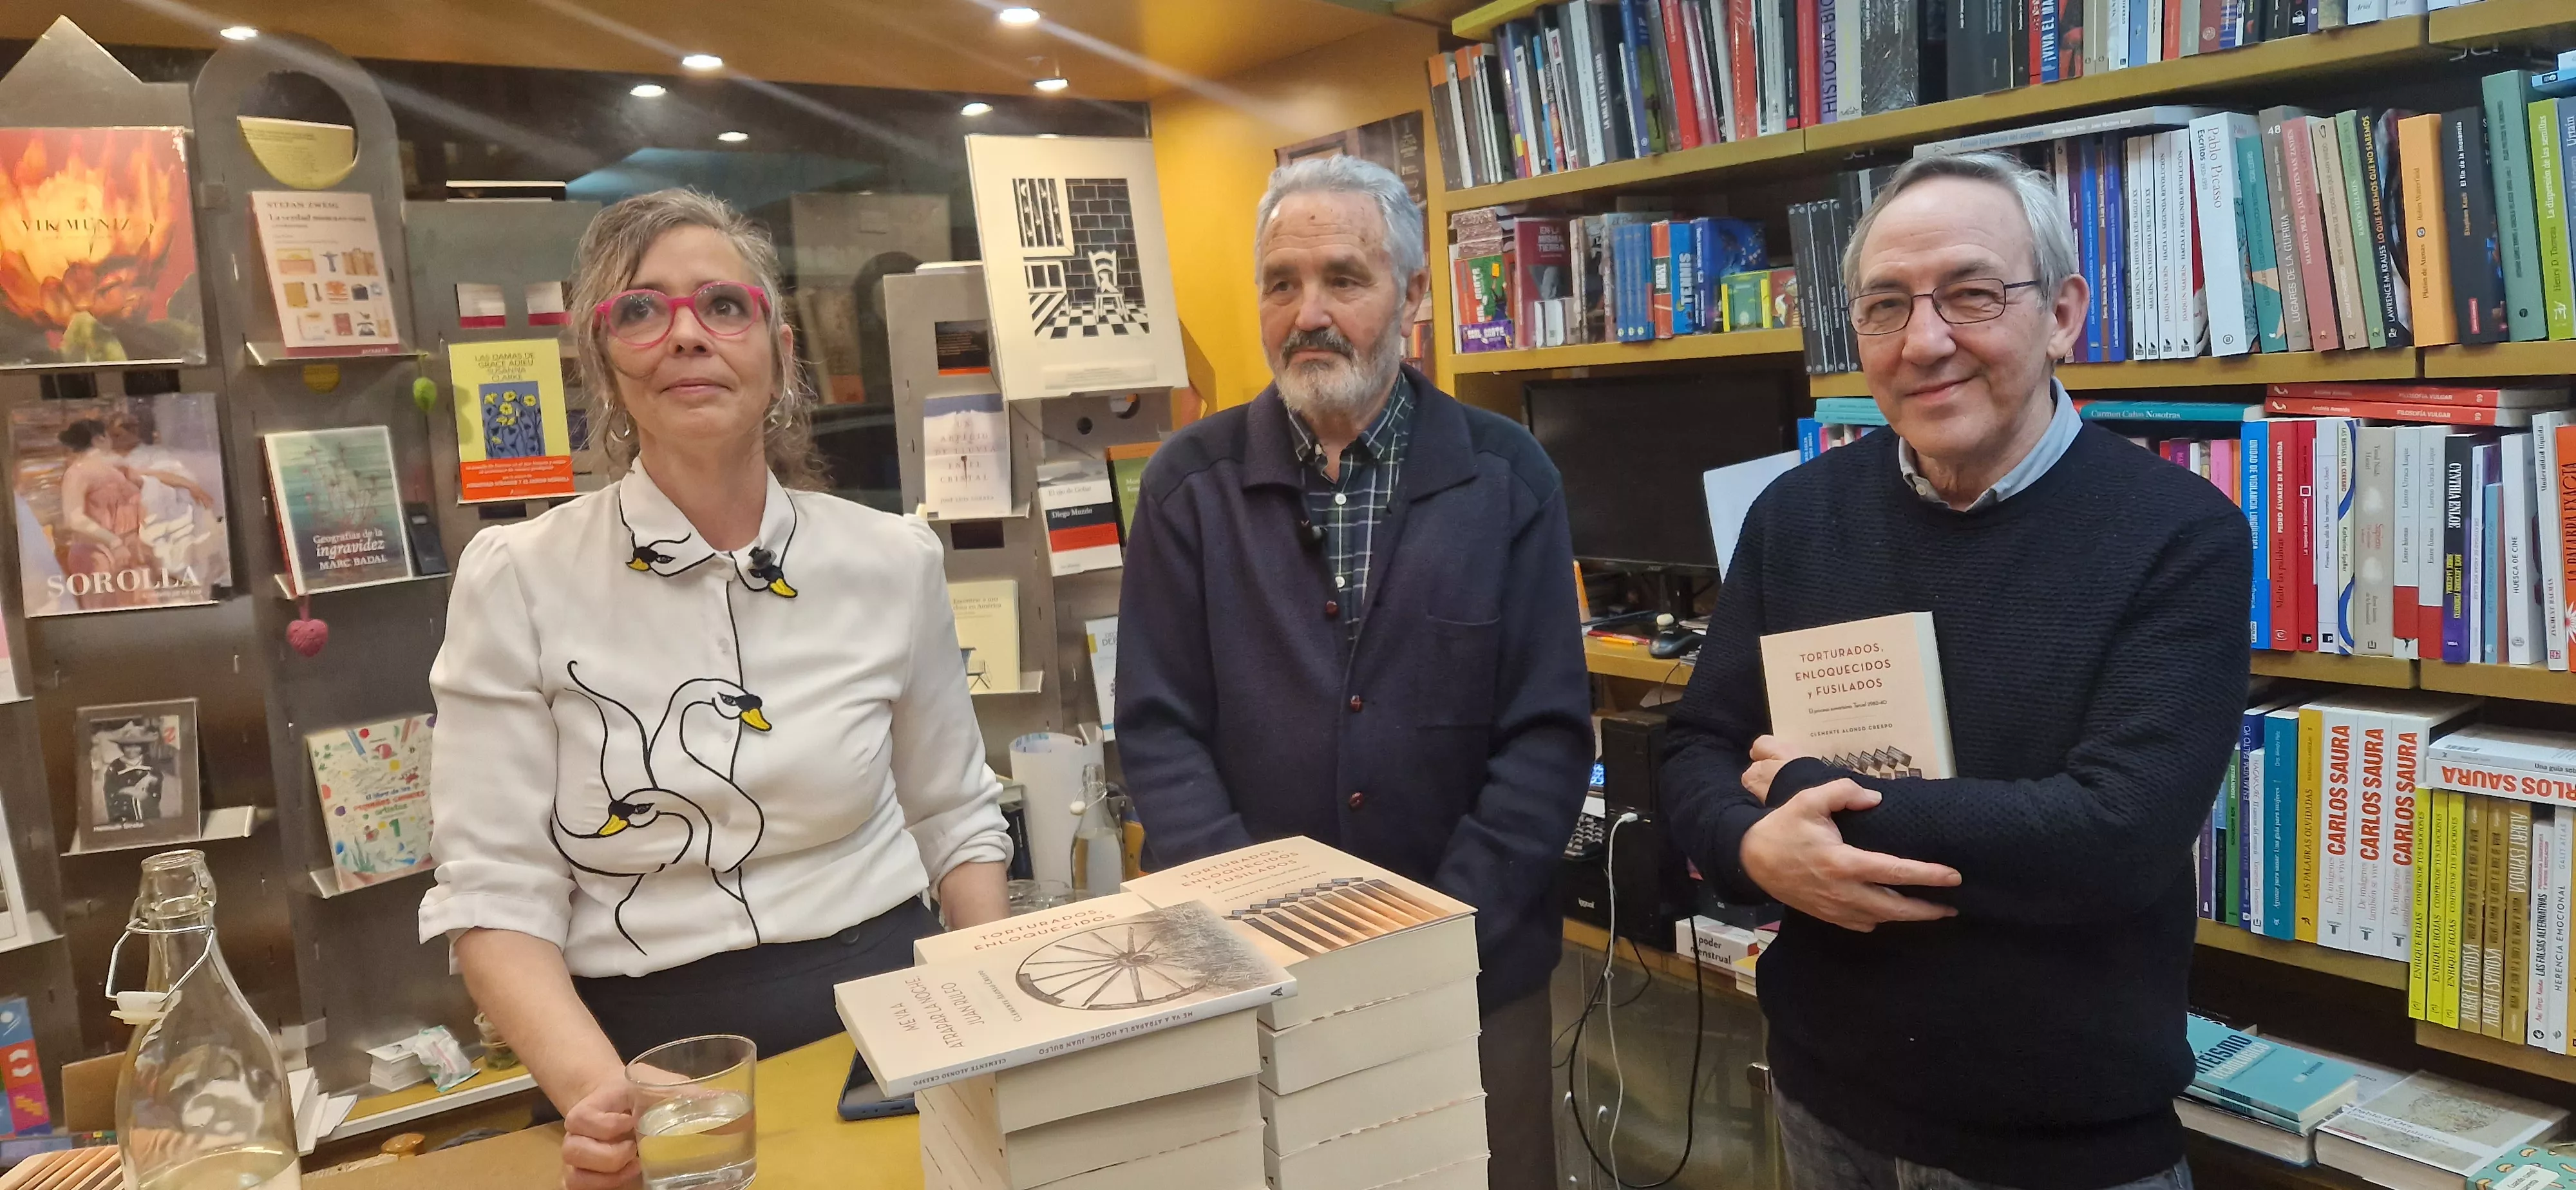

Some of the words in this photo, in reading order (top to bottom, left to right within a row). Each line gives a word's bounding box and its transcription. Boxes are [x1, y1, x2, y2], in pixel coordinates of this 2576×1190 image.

[2268, 125, 2281, 135] 48
[2362, 115, 2374, 151] SABEMOS
[2538, 115, 2549, 146] semillas
[2197, 129, 2207, 162] Escritos
[2208, 126, 2221, 162] Pablo
[2366, 151, 2376, 164] NO
[2368, 165, 2378, 181] QUE
[2211, 165, 2224, 209] Picasso
[2370, 180, 2383, 216] SABEMOS
[2543, 171, 2555, 208] dispersión
[23, 219, 59, 232] VIK
[2280, 213, 2293, 252] GUERRA
[2376, 216, 2385, 232] QUE
[2378, 232, 2385, 244] LO
[2286, 254, 2295, 267] LA
[2378, 245, 2390, 272] KRAUSS
[1678, 252, 1693, 306] TENNIS
[2287, 269, 2297, 281] DE
[2552, 269, 2562, 292] Henry
[2289, 282, 2302, 323] LUGARES
[2383, 282, 2395, 323] LAWRENCE
[2145, 411, 2181, 419] Nosotras
[2427, 410, 2451, 419] VULGAR
[2249, 439, 2259, 464] UNIDAD
[940, 474, 989, 483] CRISTAL
[2448, 462, 2462, 500] CYNTHIA
[2539, 450, 2548, 492] Modernidad
[2249, 475, 2259, 509] VIGILANCIA
[1052, 510, 1070, 518] Diego
[2448, 500, 2462, 529] ENLOE
[374, 527, 383, 538] la
[2373, 524, 2383, 549] Sapiens
[316, 537, 386, 560] ingravidez
[2275, 539, 2286, 571] palabras
[2512, 554, 2519, 563] DE
[319, 558, 350, 571] MARC
[354, 554, 388, 566] BADAL
[46, 565, 201, 598] SOROLLA
[1799, 643, 1884, 663] TORTURADOS,
[1795, 659, 1892, 681] ENLOQUECIDOS
[1808, 691, 1813, 699] y
[1815, 678, 1883, 696] FUSILADOS
[1810, 729, 1840, 737] CLEMENTE
[2329, 725, 2350, 786] SAURA
[2362, 728, 2383, 789] SAURA
[2396, 732, 2418, 794] SAURA
[2549, 764, 2563, 773] guía
[2441, 766, 2518, 793] SAURA
[2304, 788, 2313, 838] OLVIDADAS
[2327, 787, 2348, 856] CARLOS
[2360, 789, 2381, 861] CARLOS
[2392, 794, 2415, 866] CARLOS
[2509, 811, 2528, 848] ALBERT
[1181, 851, 1300, 887] ENLOQUECIDOS
[1213, 859, 1298, 886] FUSILADOS
[2304, 838, 2312, 882] PALABRAS
[2508, 848, 2527, 892] ESPINOSA
[2326, 857, 2334, 891] imágenes
[2358, 863, 2368, 898] imágenes
[2303, 883, 2311, 900] LAS
[2335, 883, 2345, 916] también
[2368, 888, 2378, 921] también
[2415, 912, 2423, 939] ROJAS
[2537, 894, 2548, 940] ALTERNATIVAS
[2555, 885, 2566, 941] EMOCIONAL
[973, 912, 1116, 951] ENLOQUECIDOS
[2432, 914, 2441, 941] ROJAS
[2448, 919, 2456, 946] ROJAS
[1698, 937, 1722, 949] poder
[2537, 940, 2546, 963] FALSAS
[2413, 940, 2424, 979] ENRIQUE
[2432, 942, 2443, 983] ENRIQUE
[2447, 947, 2458, 988] ENRIQUE
[2461, 942, 2480, 987] ESPINOSA
[2483, 947, 2501, 992] ESPINOSA
[2537, 963, 2546, 977] LAS
[2555, 945, 2564, 992] HERENCIA
[940, 981, 969, 1006] RULFO
[2461, 987, 2479, 1023] ALBERT
[894, 1008, 911, 1020] VA
[923, 1002, 942, 1014] LA
[957, 1005, 985, 1025] JUAN
[1182, 1010, 1193, 1019] ME
[2483, 991, 2499, 1028] ALBERT
[899, 1018, 920, 1032] ME
[929, 1013, 965, 1049] ATRAPAR
[1119, 1026, 1129, 1034] LA
[1130, 1018, 1163, 1033] ATRAPAR
[1038, 1043, 1064, 1055] RULFO
[1066, 1037, 1086, 1049] JUAN
[942, 1066, 969, 1080] ALONSO
[971, 1057, 1007, 1072] CLEMENTE
[913, 1073, 940, 1086] CRESPO
